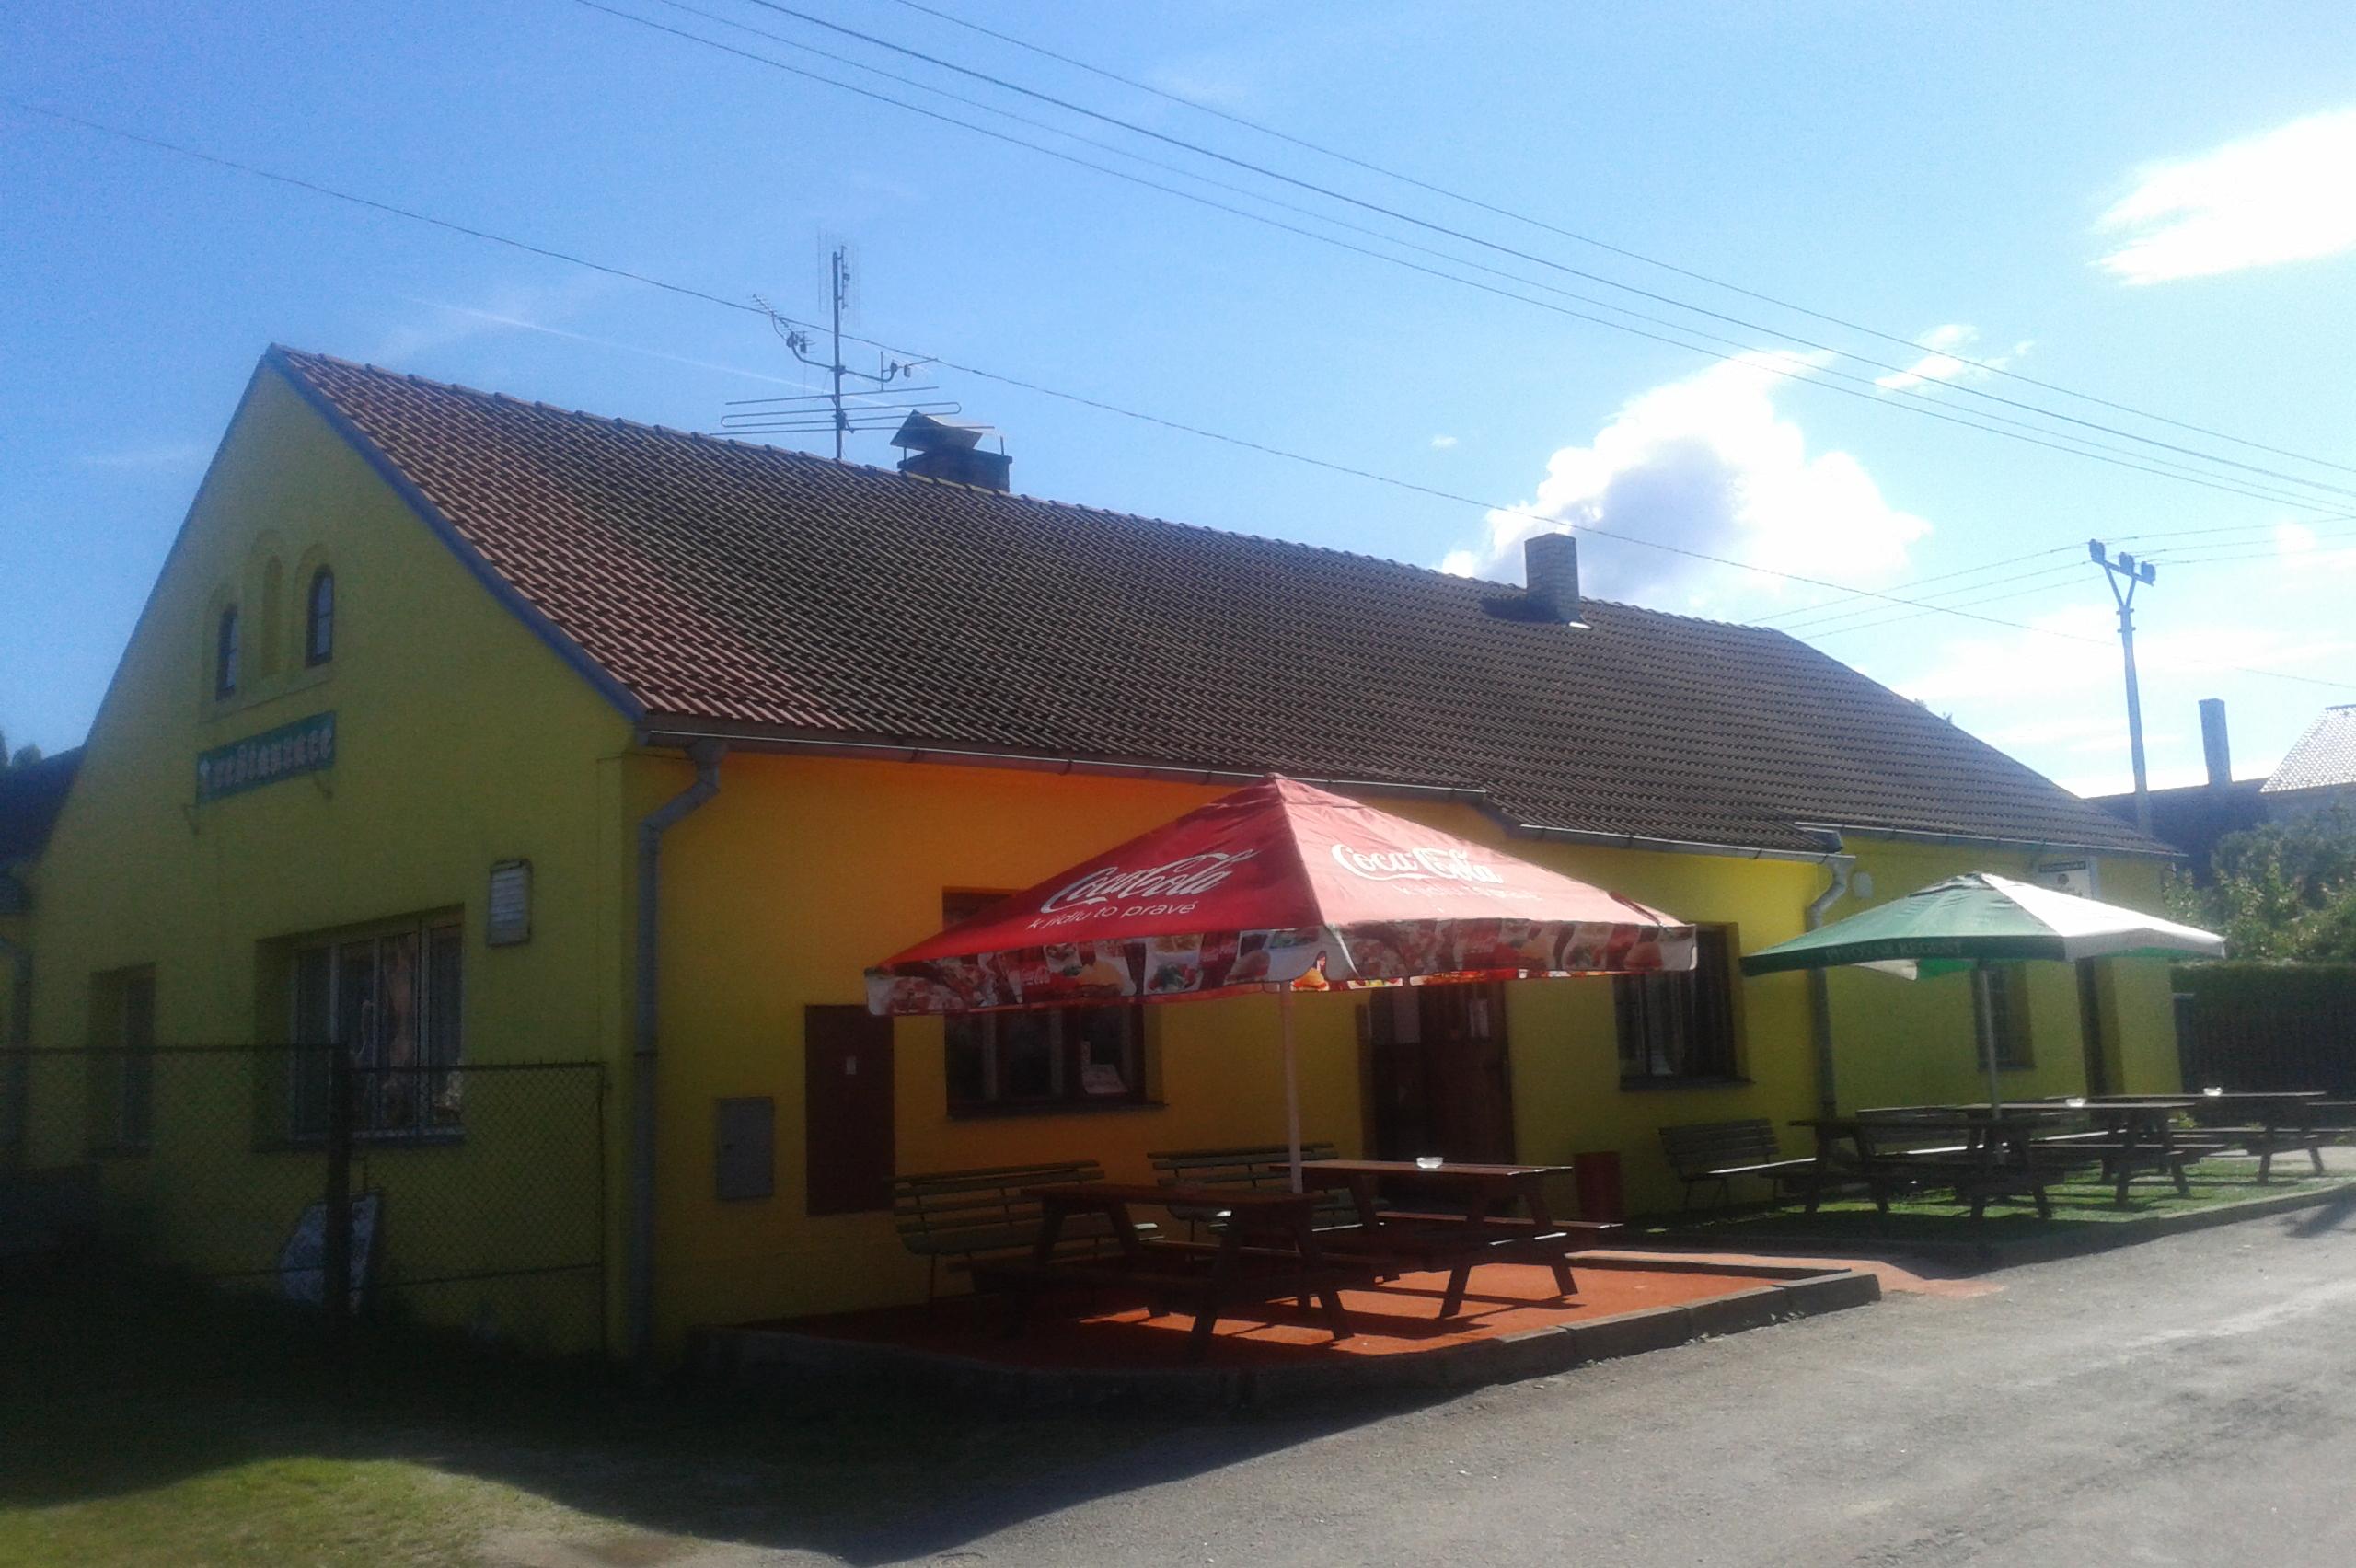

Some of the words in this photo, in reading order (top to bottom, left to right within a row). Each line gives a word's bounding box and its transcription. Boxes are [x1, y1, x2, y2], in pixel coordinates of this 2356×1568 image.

[1040, 848, 1260, 913] Coca-Cola
[1331, 843, 1504, 884] Coca-Cola
[1093, 905, 1118, 918] to
[1120, 901, 1197, 918] pravé
